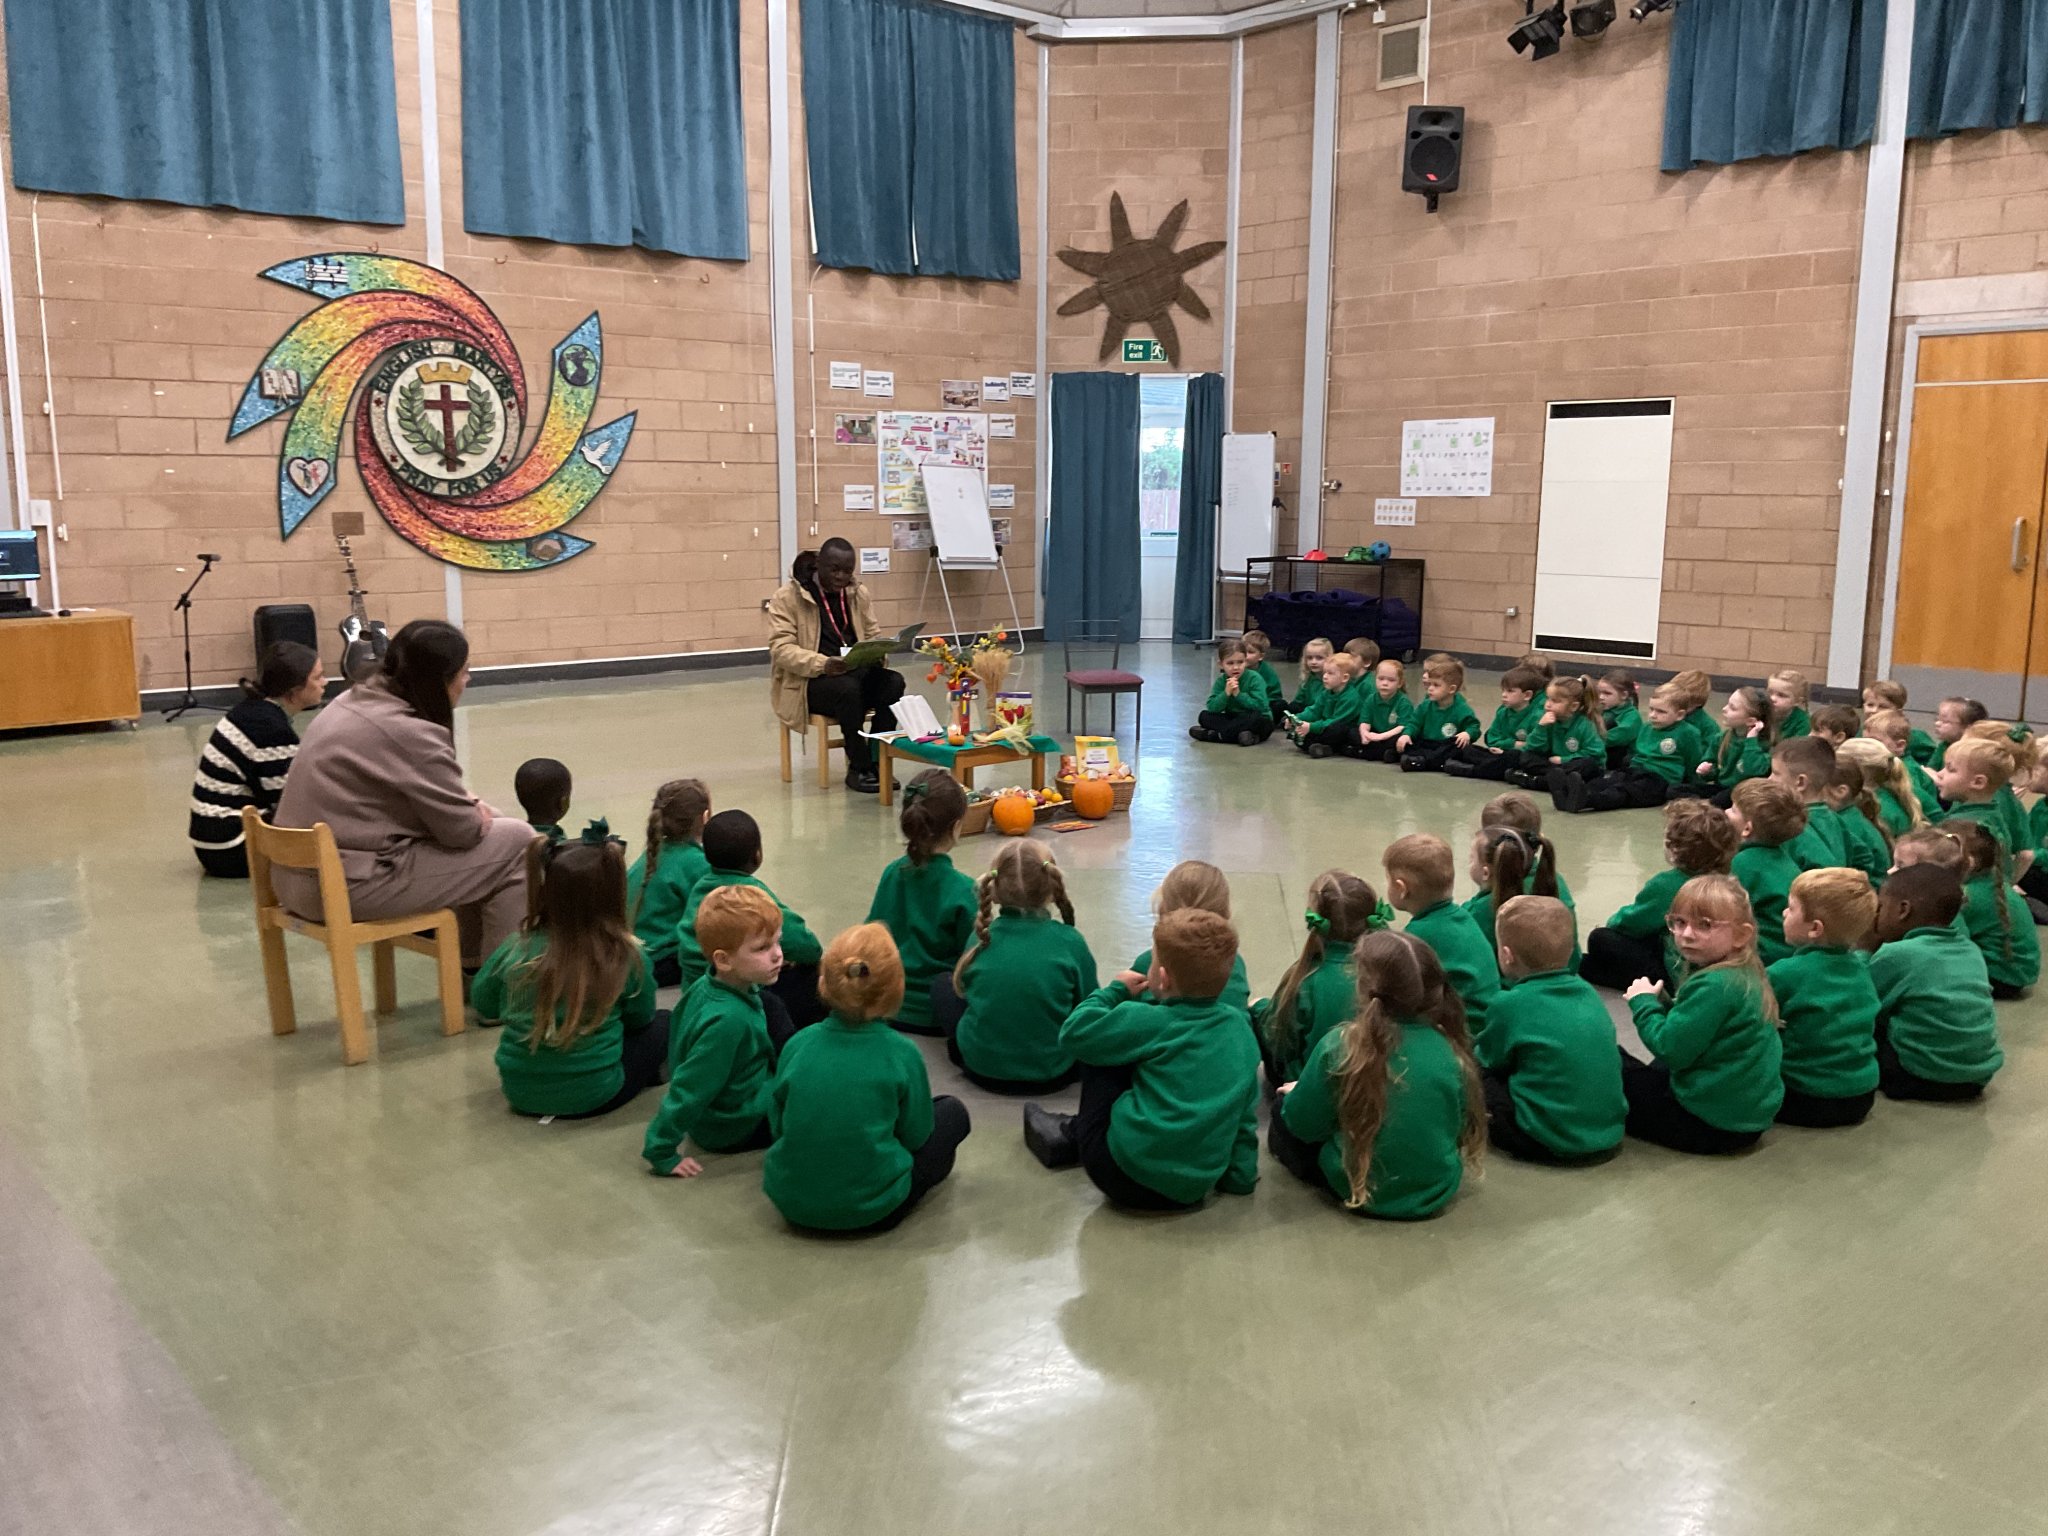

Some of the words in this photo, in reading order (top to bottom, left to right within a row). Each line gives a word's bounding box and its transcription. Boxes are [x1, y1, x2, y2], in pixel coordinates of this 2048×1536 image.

[374, 341, 433, 394] ENGLISH
[454, 341, 516, 400] MARTYRS
[397, 463, 440, 495] PRAY
[448, 478, 482, 496] FOR
[481, 464, 503, 485] US
